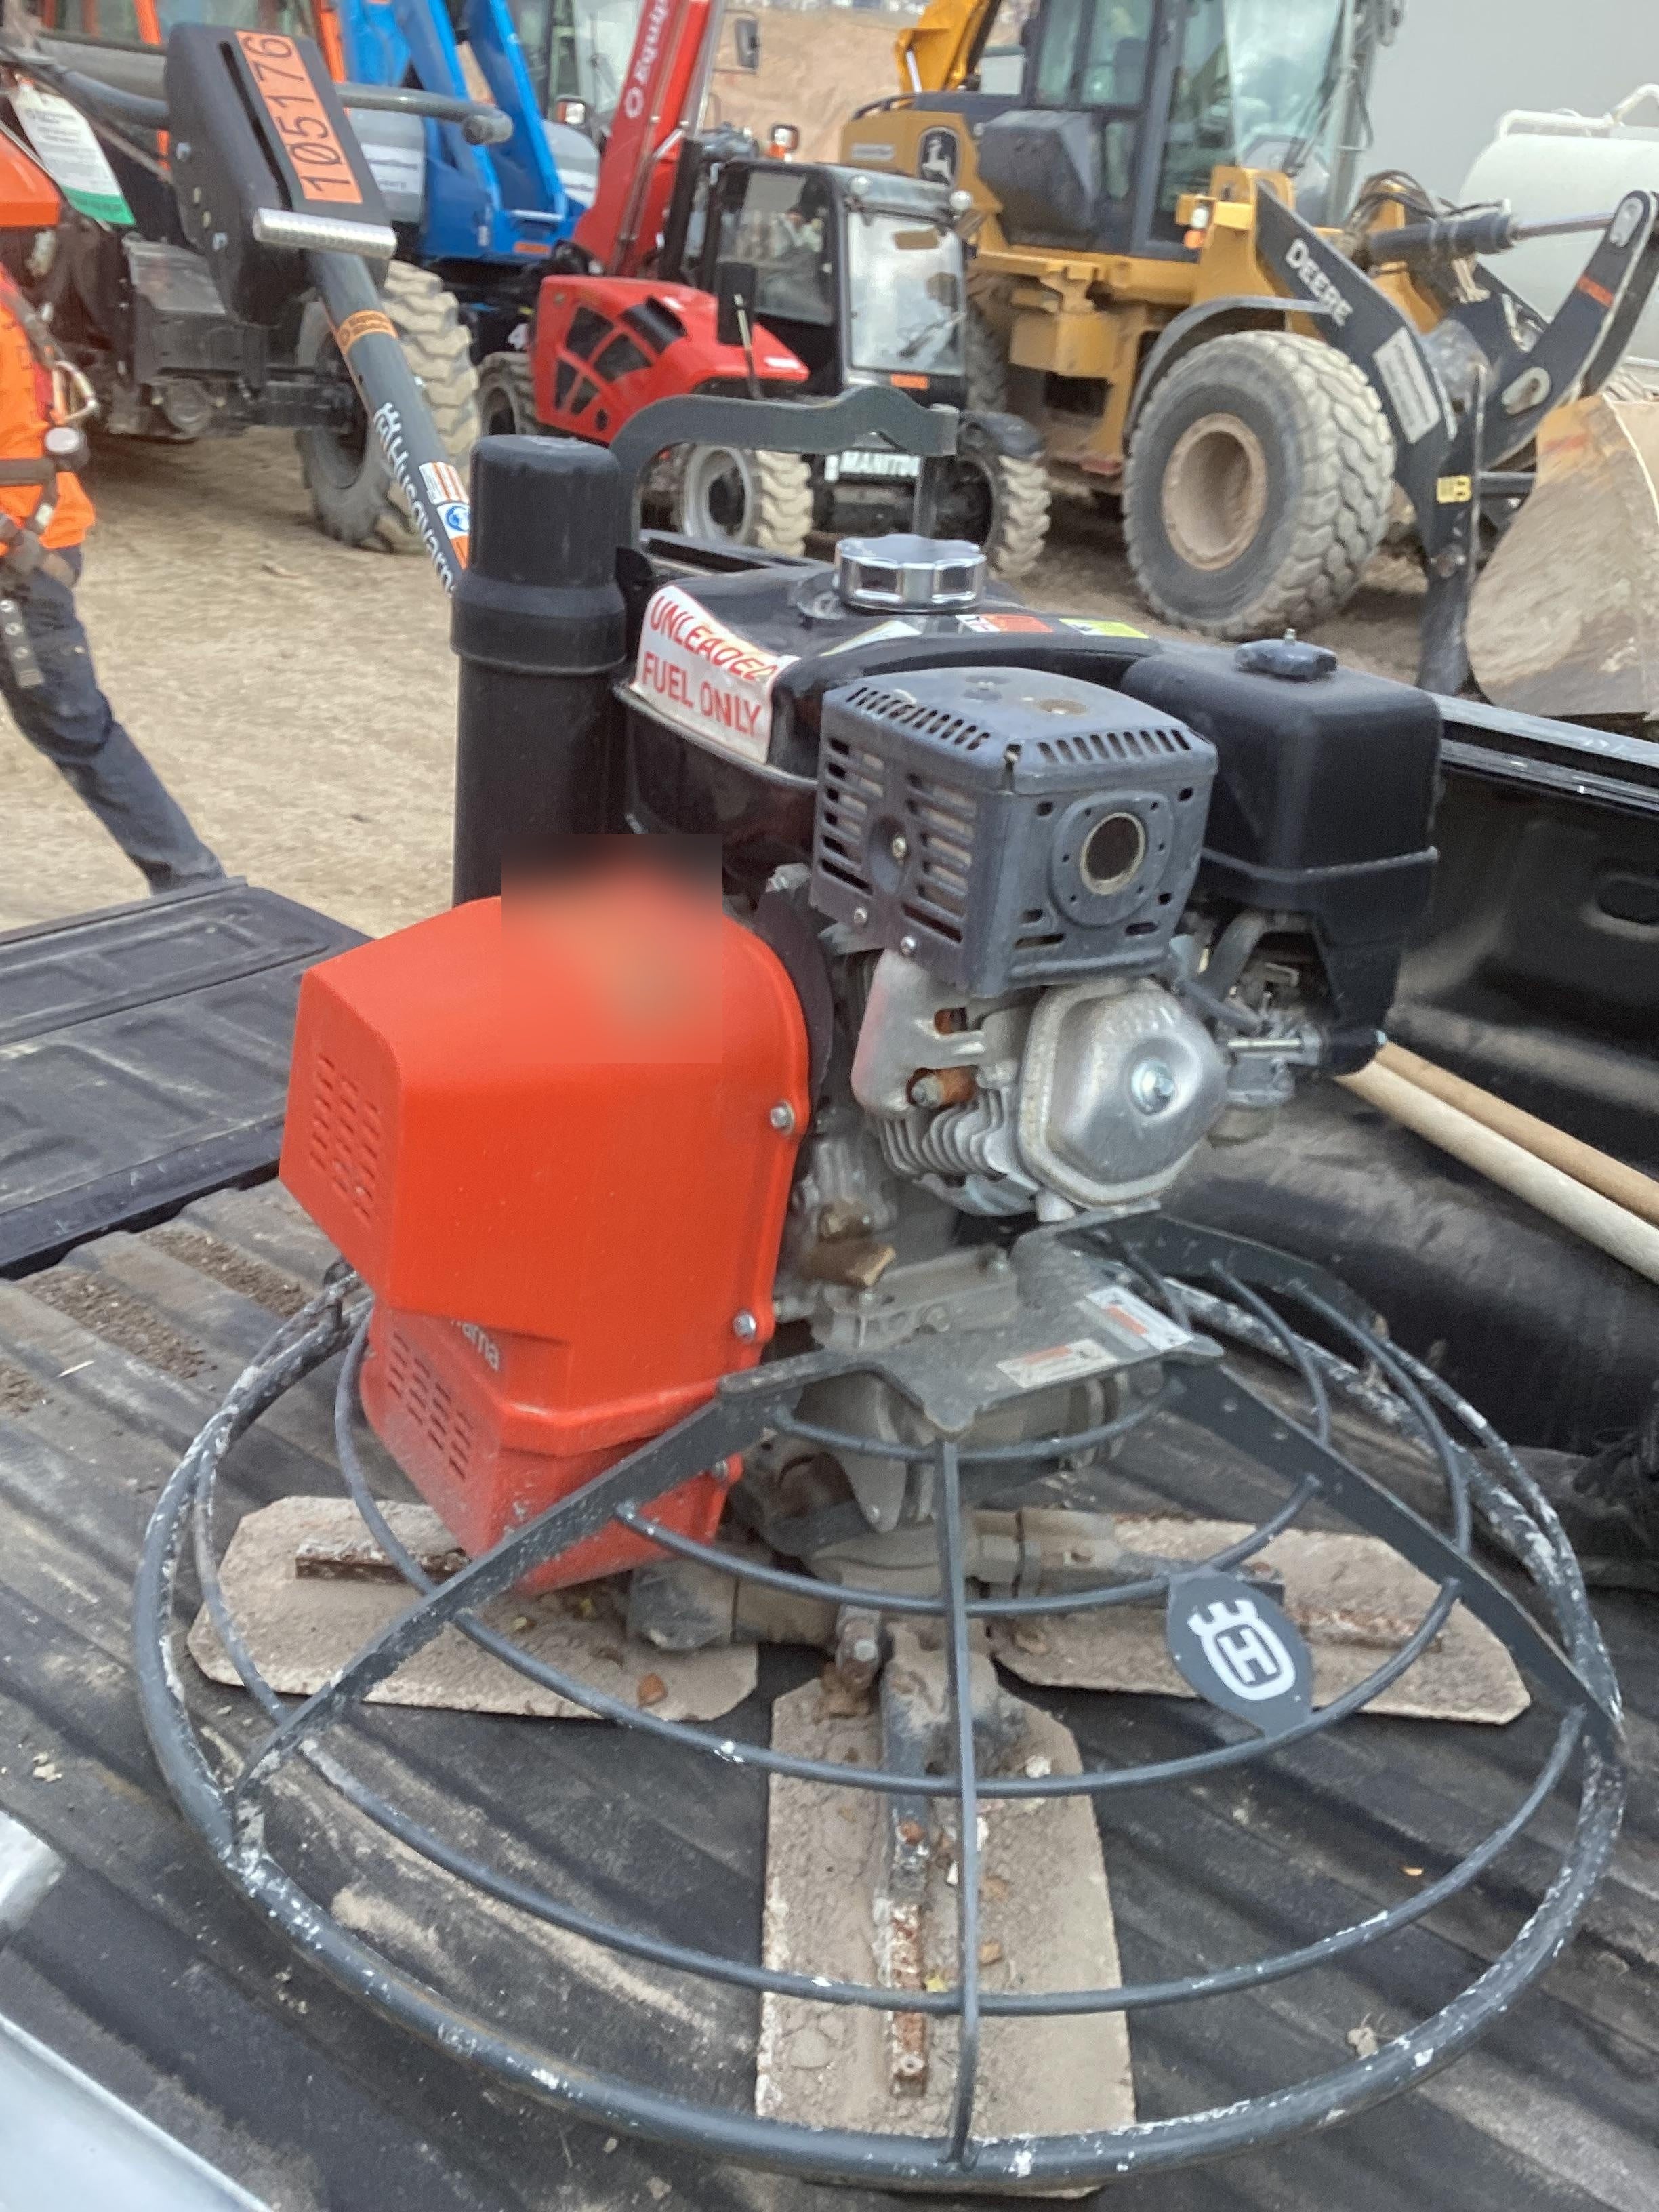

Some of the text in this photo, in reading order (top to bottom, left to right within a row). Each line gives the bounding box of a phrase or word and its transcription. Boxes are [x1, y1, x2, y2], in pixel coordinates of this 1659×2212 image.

[242, 37, 350, 191] 105176
[1286, 238, 1353, 326] DEERE
[650, 596, 778, 680] UNLEADED
[643, 651, 762, 737] FUEL ONLY
